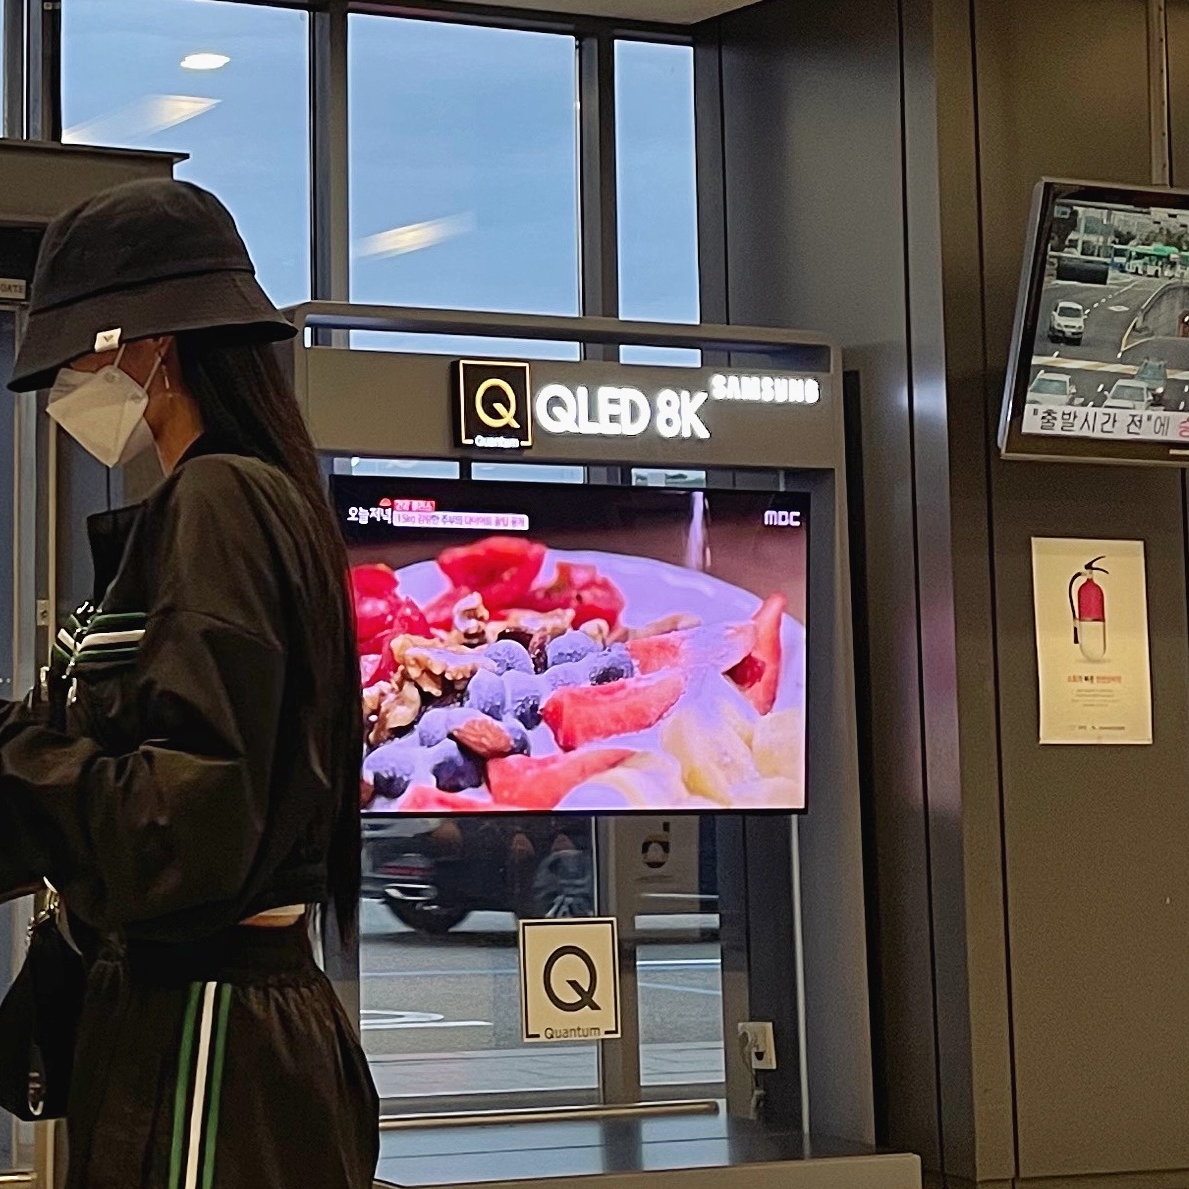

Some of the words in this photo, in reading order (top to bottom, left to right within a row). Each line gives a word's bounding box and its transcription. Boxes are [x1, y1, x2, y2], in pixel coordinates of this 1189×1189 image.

[476, 379, 520, 428] Q
[535, 384, 652, 436] QLED
[655, 389, 711, 439] 8K
[712, 374, 820, 404] SAMSUNG
[544, 945, 601, 1012] Q
[544, 1025, 601, 1040] Quantum
